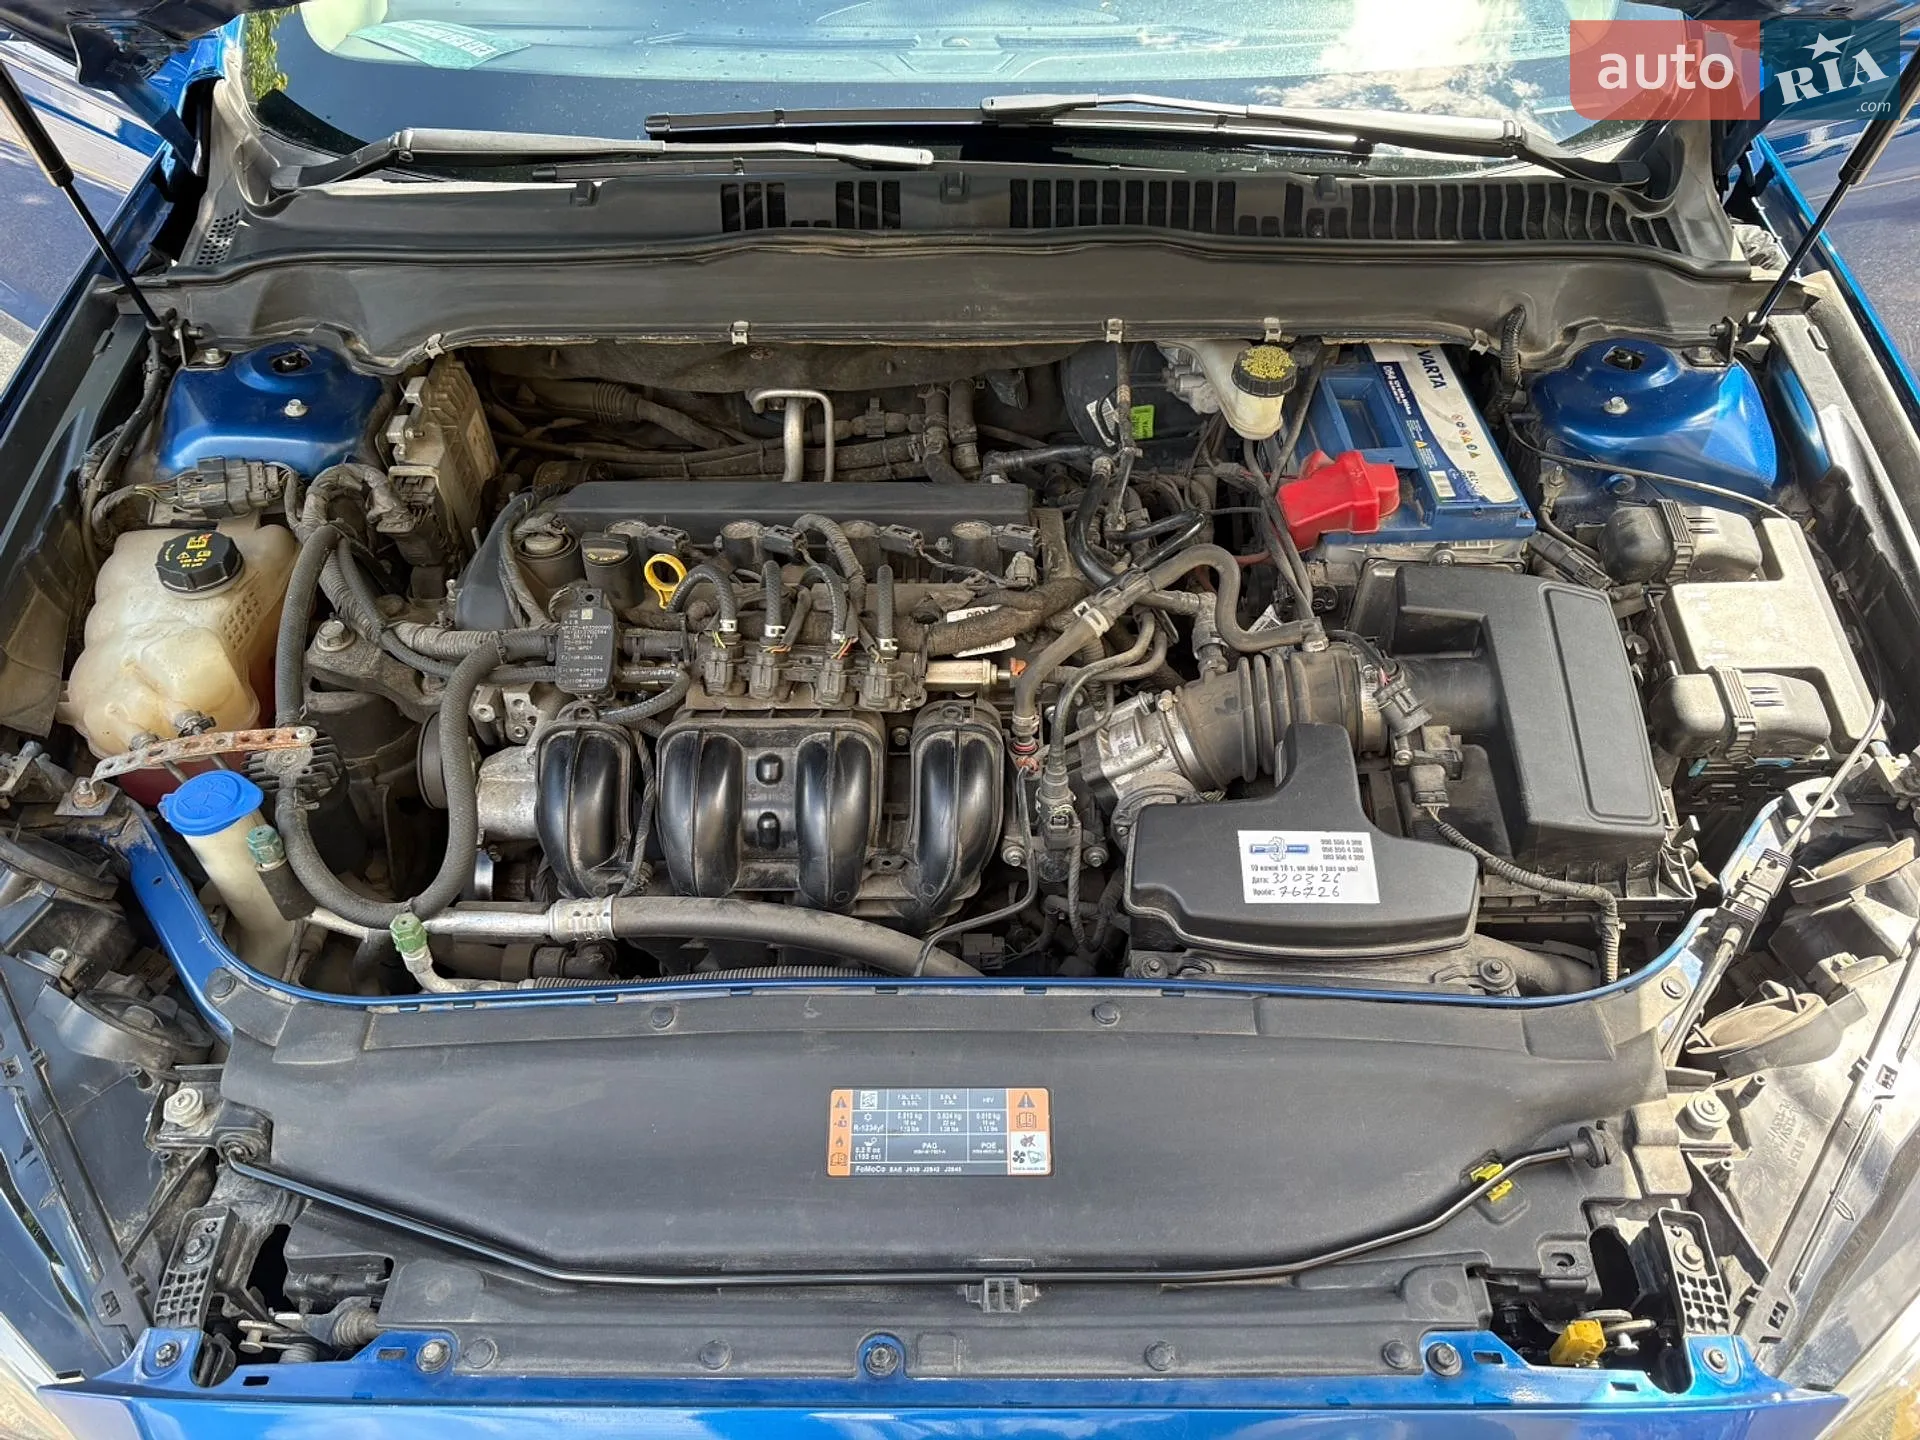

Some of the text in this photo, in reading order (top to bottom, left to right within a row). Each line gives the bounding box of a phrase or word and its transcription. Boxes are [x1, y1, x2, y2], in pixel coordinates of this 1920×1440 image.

[1417, 349, 1447, 390] VARTA
[1252, 876, 1270, 884] Дата:
[1279, 886, 1340, 898] 76726
[853, 1124, 884, 1134] R-1234yf
[980, 1141, 997, 1149] POE
[855, 1165, 886, 1173] FoMoCo
